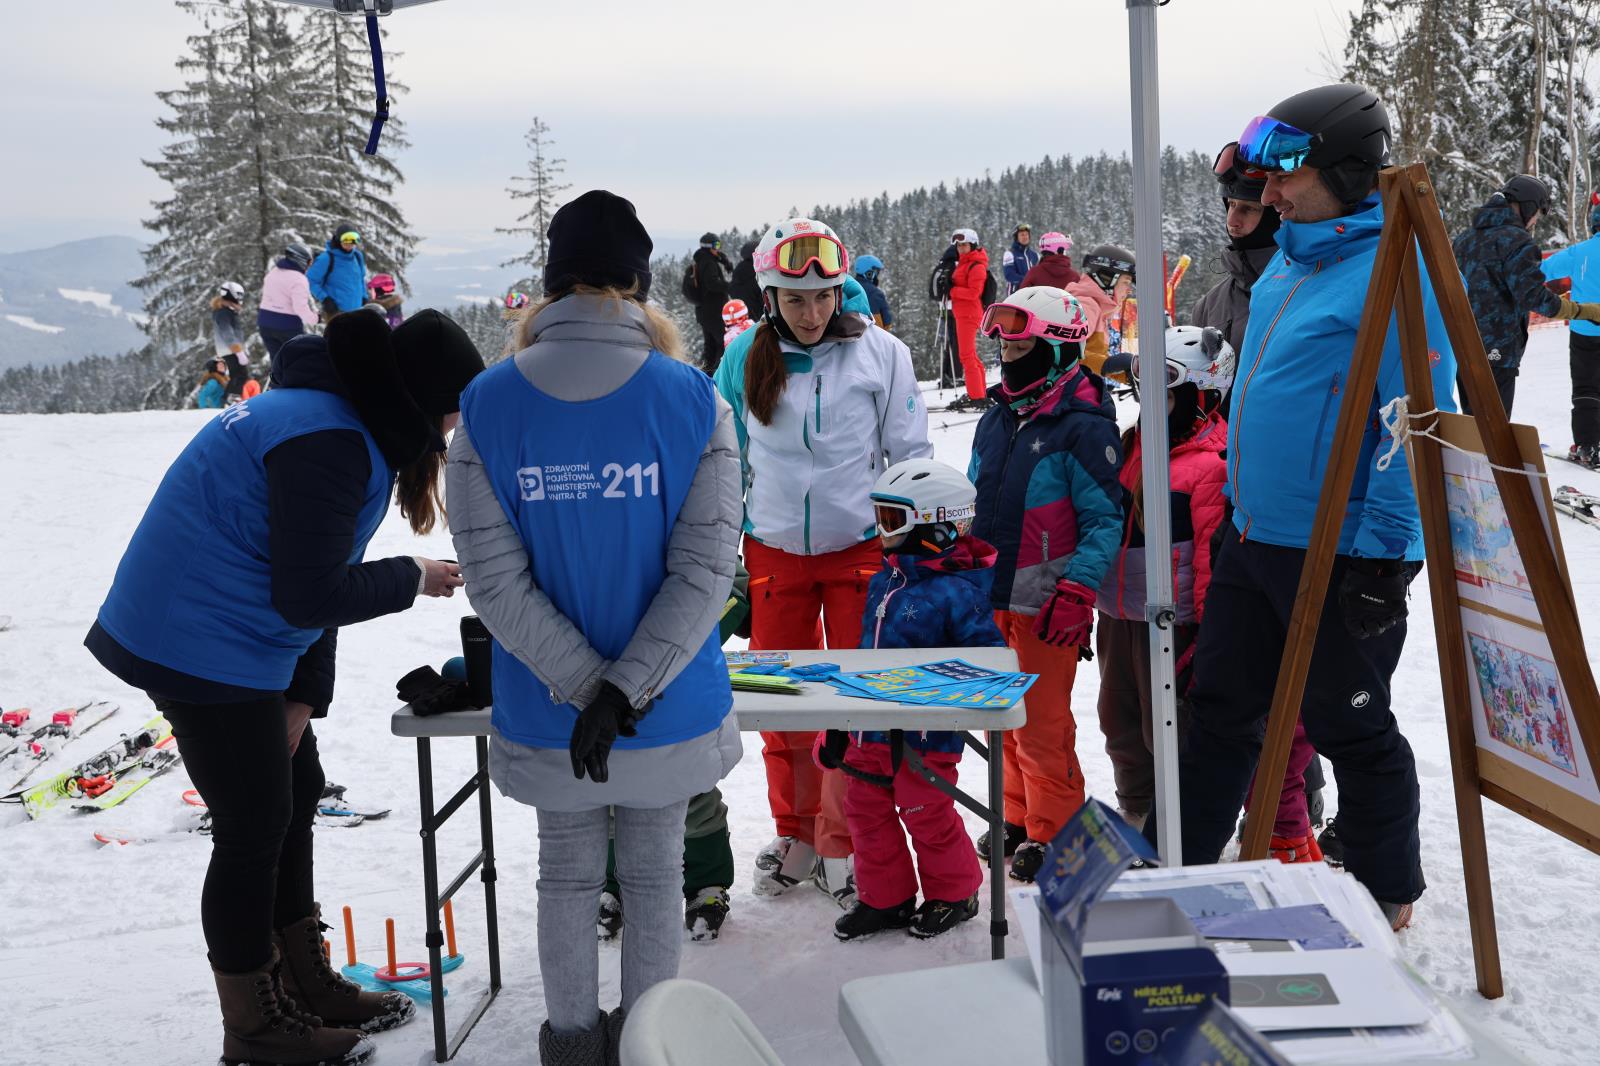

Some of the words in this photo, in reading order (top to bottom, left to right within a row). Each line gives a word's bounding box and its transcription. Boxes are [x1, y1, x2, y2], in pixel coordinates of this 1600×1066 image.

[1043, 324, 1089, 339] RELA
[544, 462, 590, 473] ZDRAVOTNÍ
[546, 471, 595, 482] POJIŠŤOVNA
[602, 462, 659, 498] 211
[547, 482, 602, 491] MINISTERSTVA
[548, 492, 575, 500] VNITRA
[577, 489, 588, 499] ČR
[946, 507, 970, 518] SCOTT
